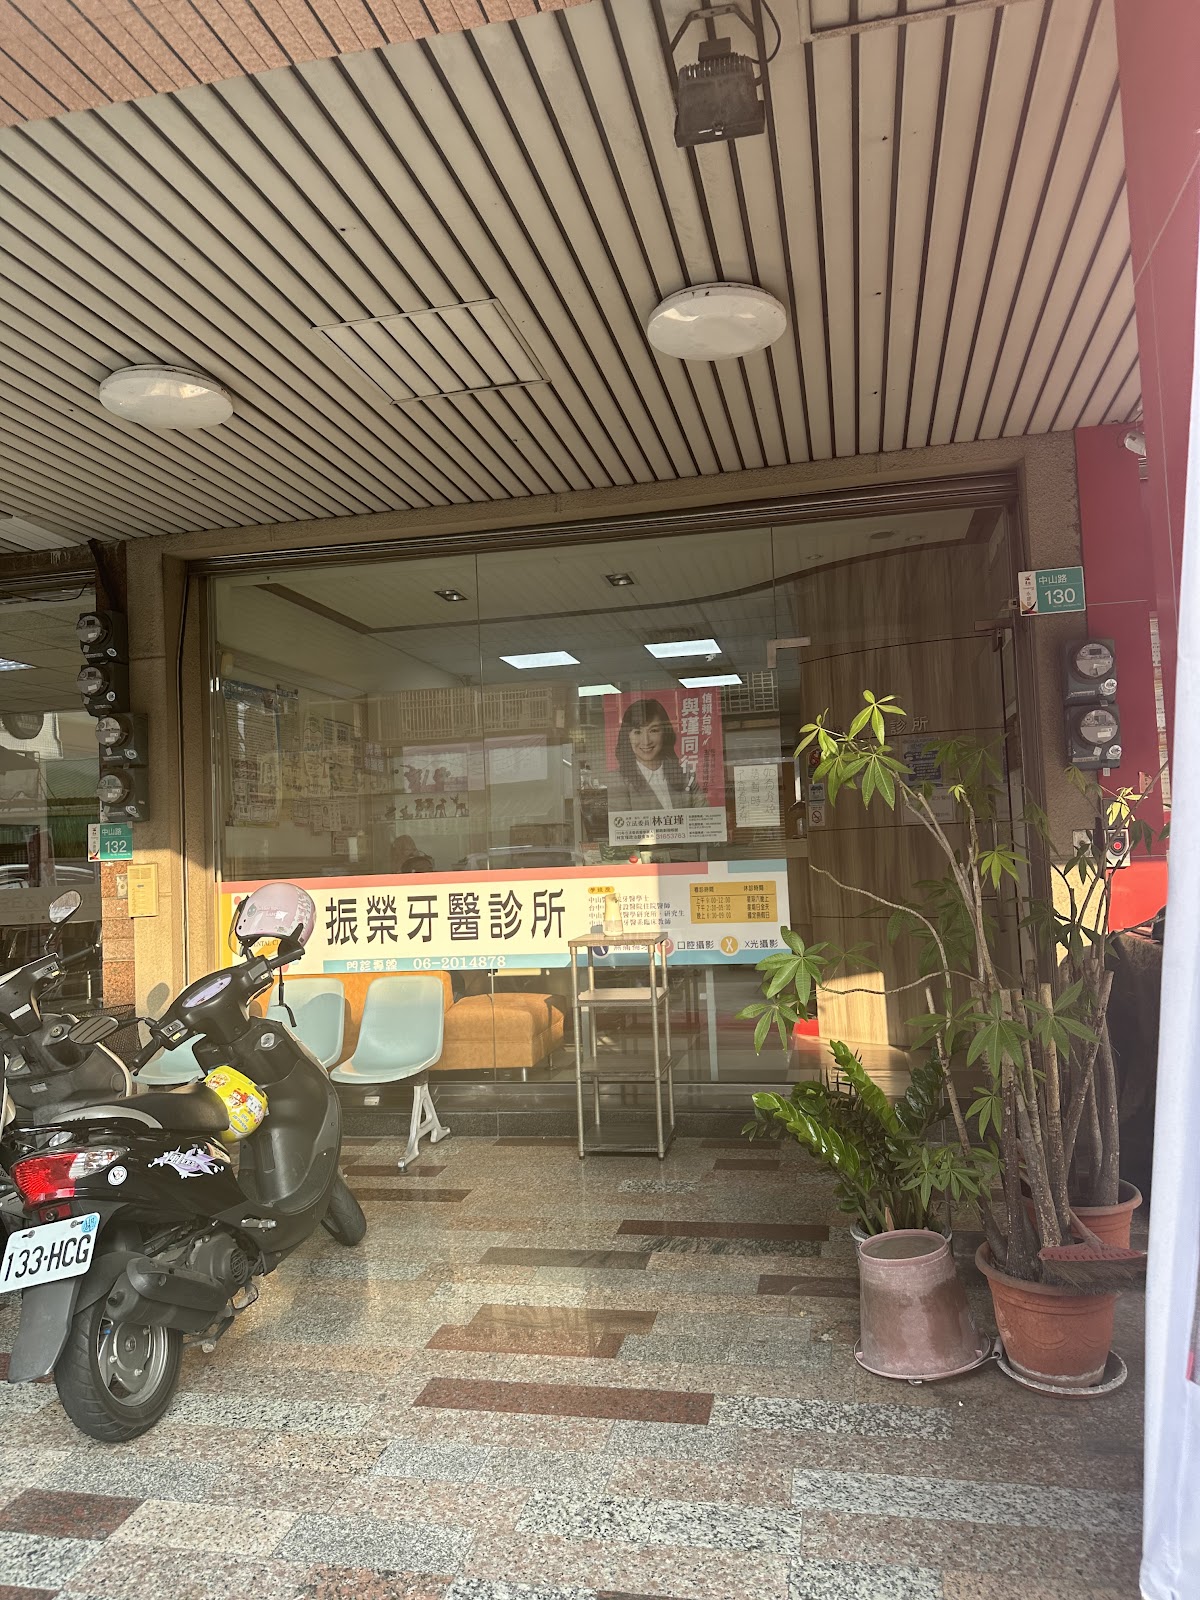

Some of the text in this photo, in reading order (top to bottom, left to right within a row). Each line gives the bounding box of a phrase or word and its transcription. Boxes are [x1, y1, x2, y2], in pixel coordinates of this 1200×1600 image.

[1038, 574, 1067, 585] 中山路
[1044, 588, 1076, 605] 130
[701, 692, 713, 736] 信賴台灣
[652, 815, 685, 827] 林宜瑾
[101, 828, 122, 836] 中山路
[105, 840, 127, 853] 132
[325, 888, 566, 946] 振榮牙醫診所
[677, 939, 715, 950] 口腔攝影
[744, 938, 779, 949] X光攝影
[413, 956, 506, 970] 06-2014878
